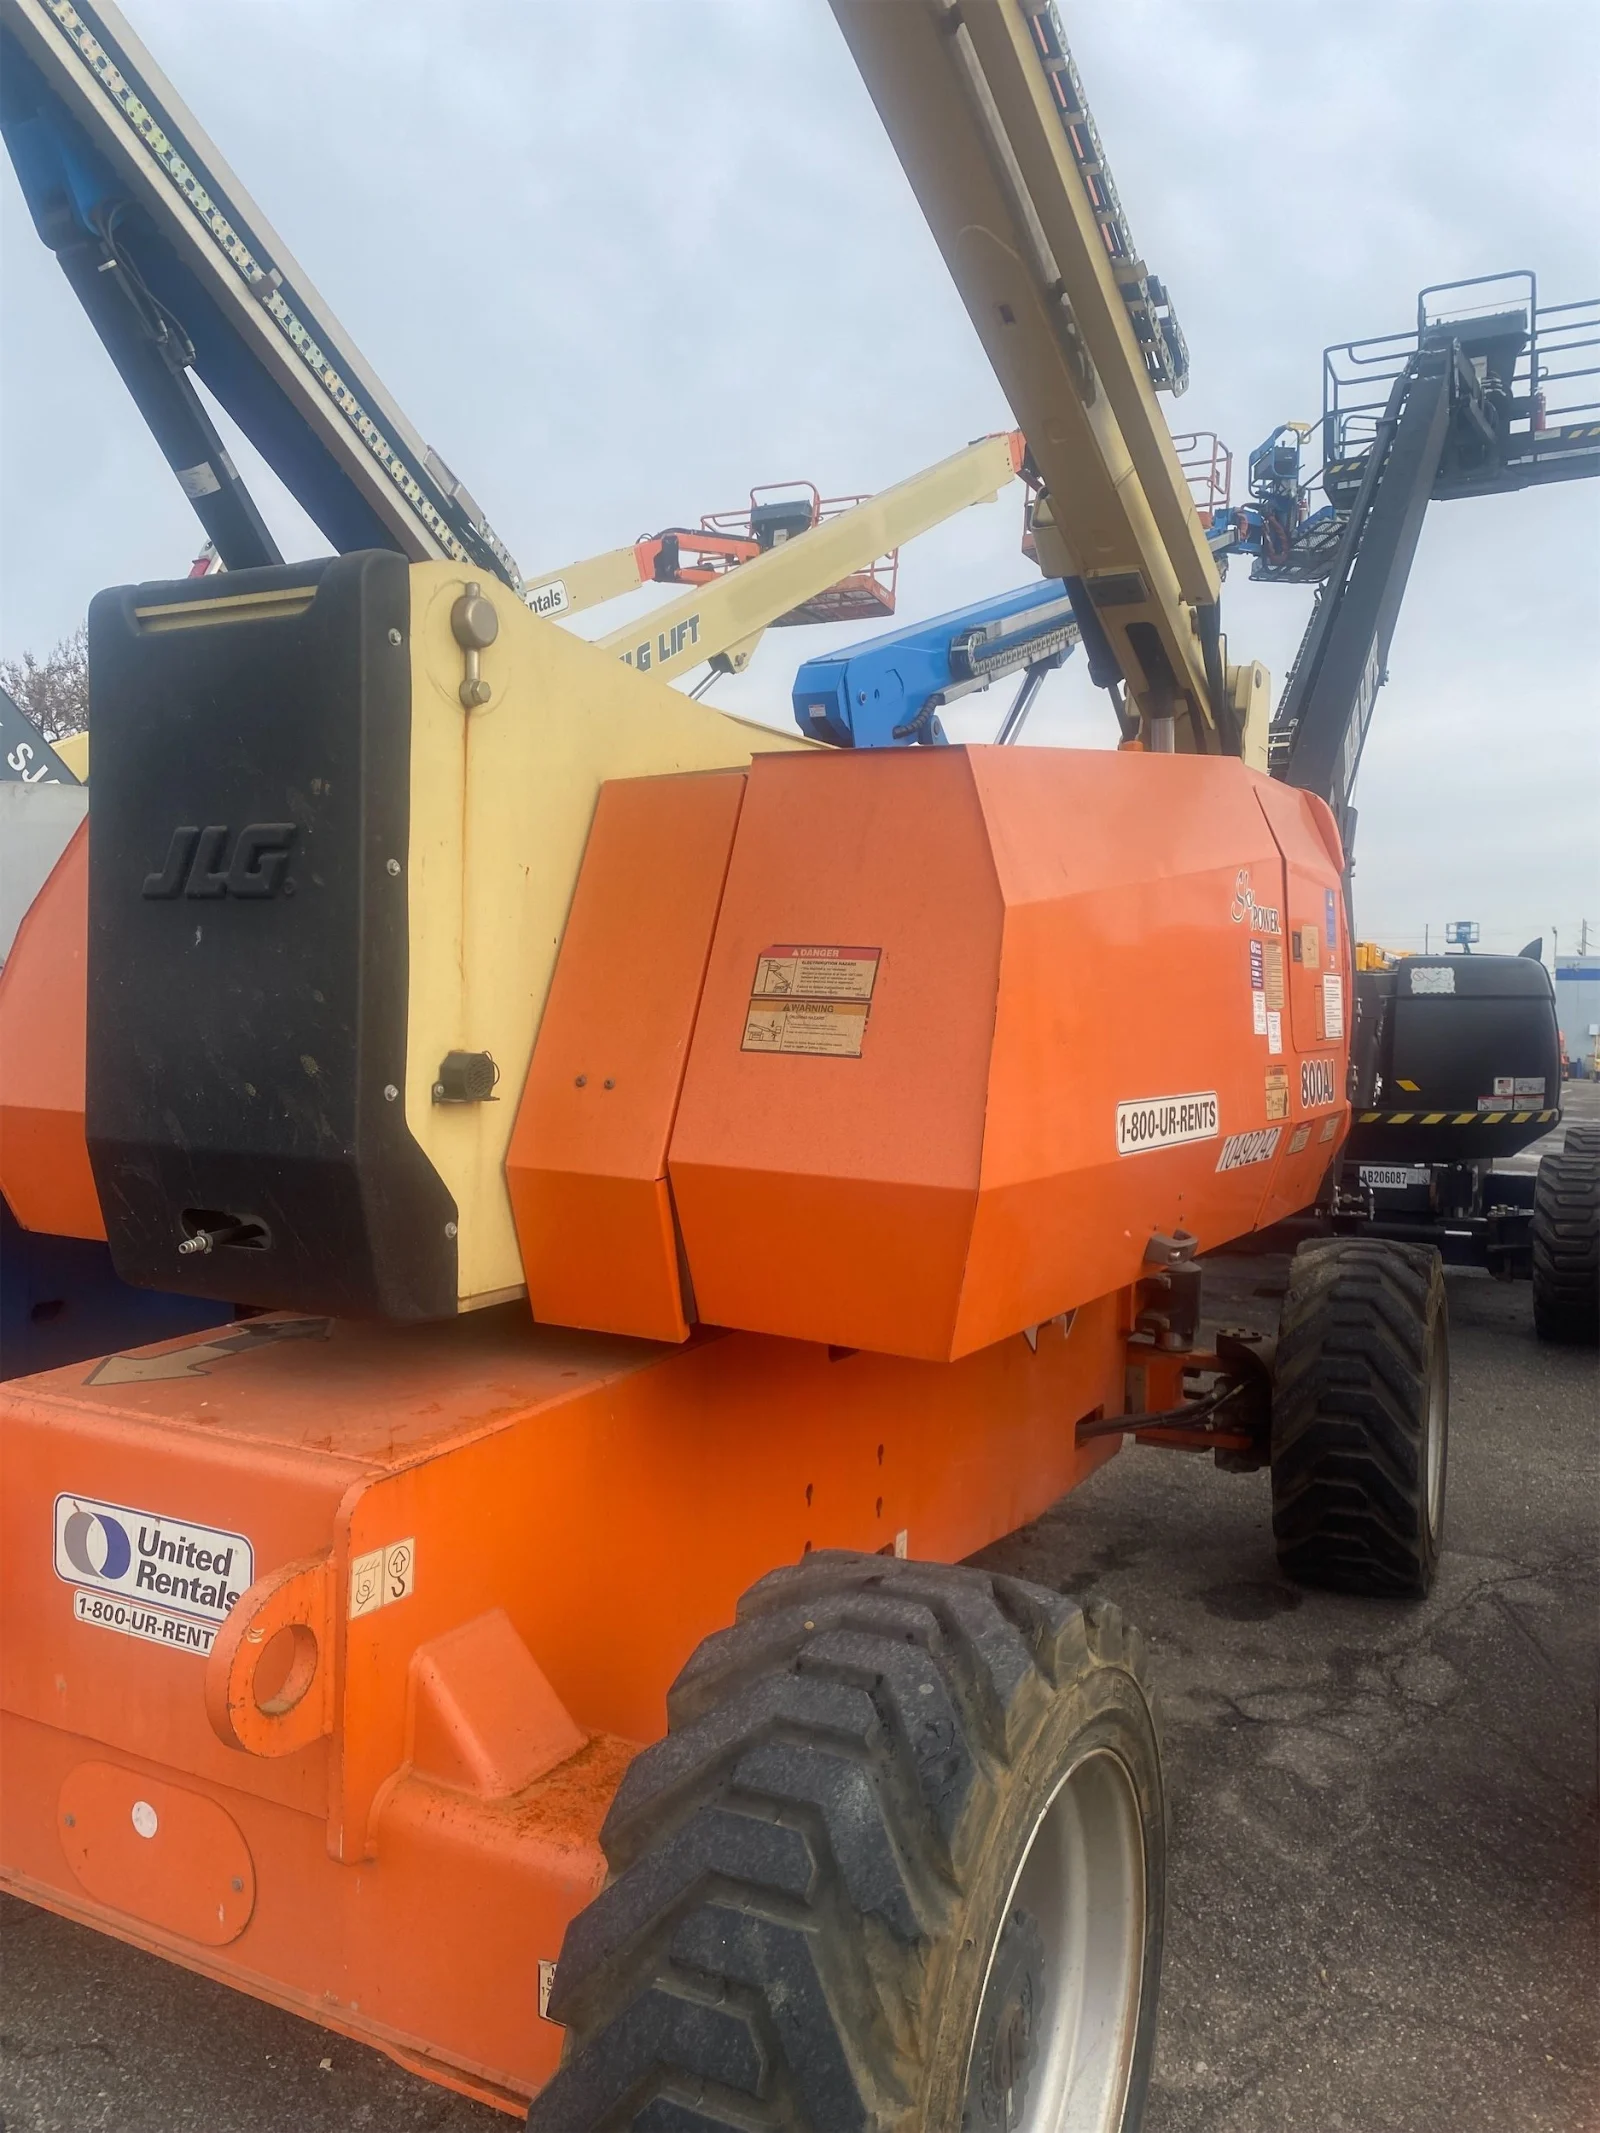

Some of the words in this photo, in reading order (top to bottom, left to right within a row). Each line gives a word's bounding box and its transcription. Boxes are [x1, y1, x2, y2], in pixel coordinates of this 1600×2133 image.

[525, 589, 561, 613] ntals
[658, 612, 700, 664] LIFT
[141, 823, 297, 899] JLG
[800, 948, 840, 958] DANGER
[791, 1003, 834, 1013] WARNING
[1301, 1059, 1335, 1109] 800AJ
[1120, 1100, 1216, 1144] 1-800-UR-RENTS
[1220, 1128, 1279, 1170] 10492242
[137, 1526, 234, 1577] United
[135, 1560, 241, 1612] Rentals
[78, 1597, 215, 1650] 1-800-UR-RENT
